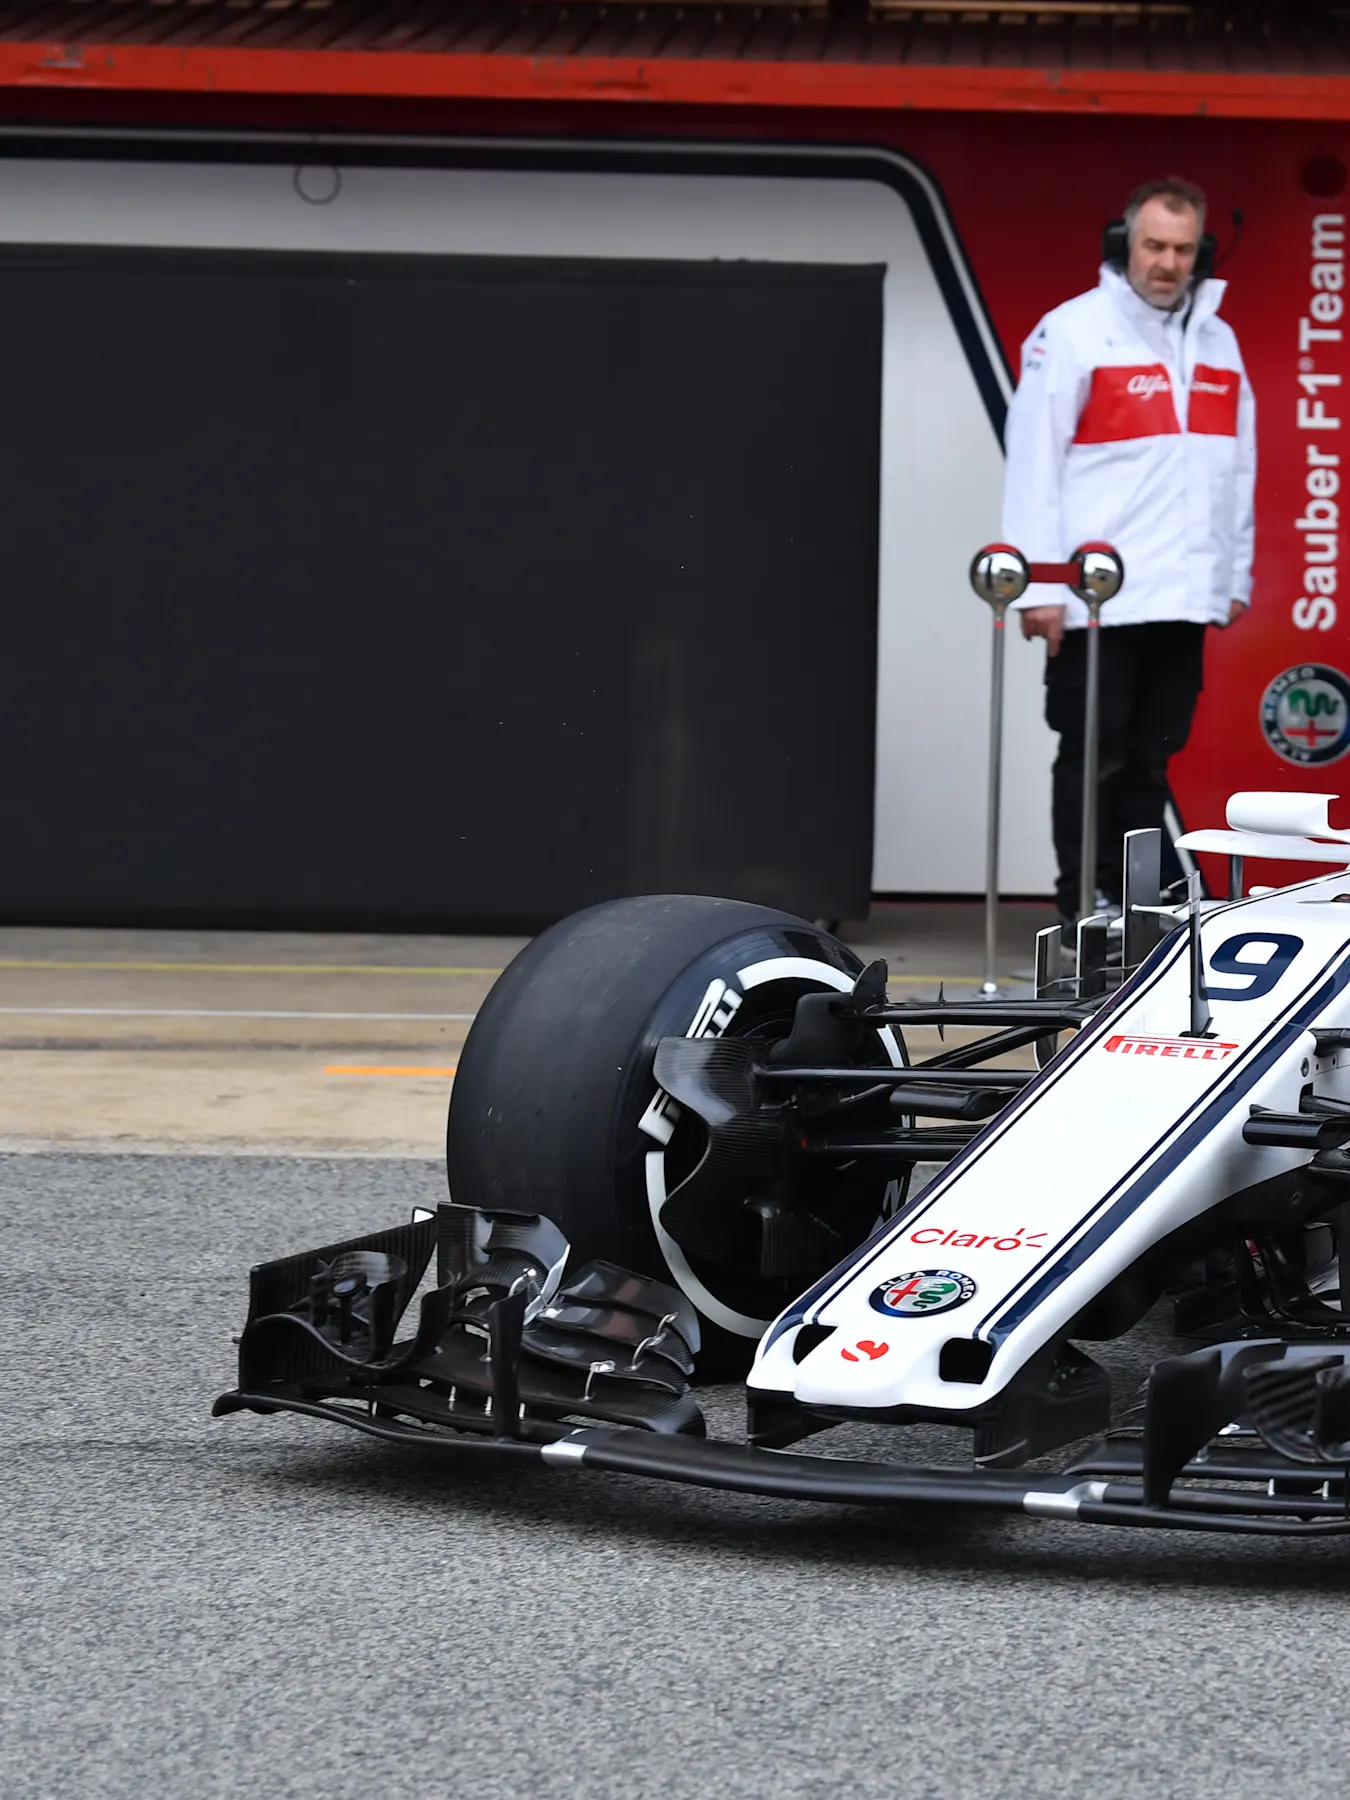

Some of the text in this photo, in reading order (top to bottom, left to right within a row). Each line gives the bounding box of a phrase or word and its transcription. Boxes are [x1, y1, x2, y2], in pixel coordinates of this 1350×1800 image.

[1298, 213, 1345, 353] Team
[1292, 444, 1341, 631] Sauber
[1207, 932, 1304, 1002] 9
[879, 1270, 974, 1300] ALFA ROMEO
